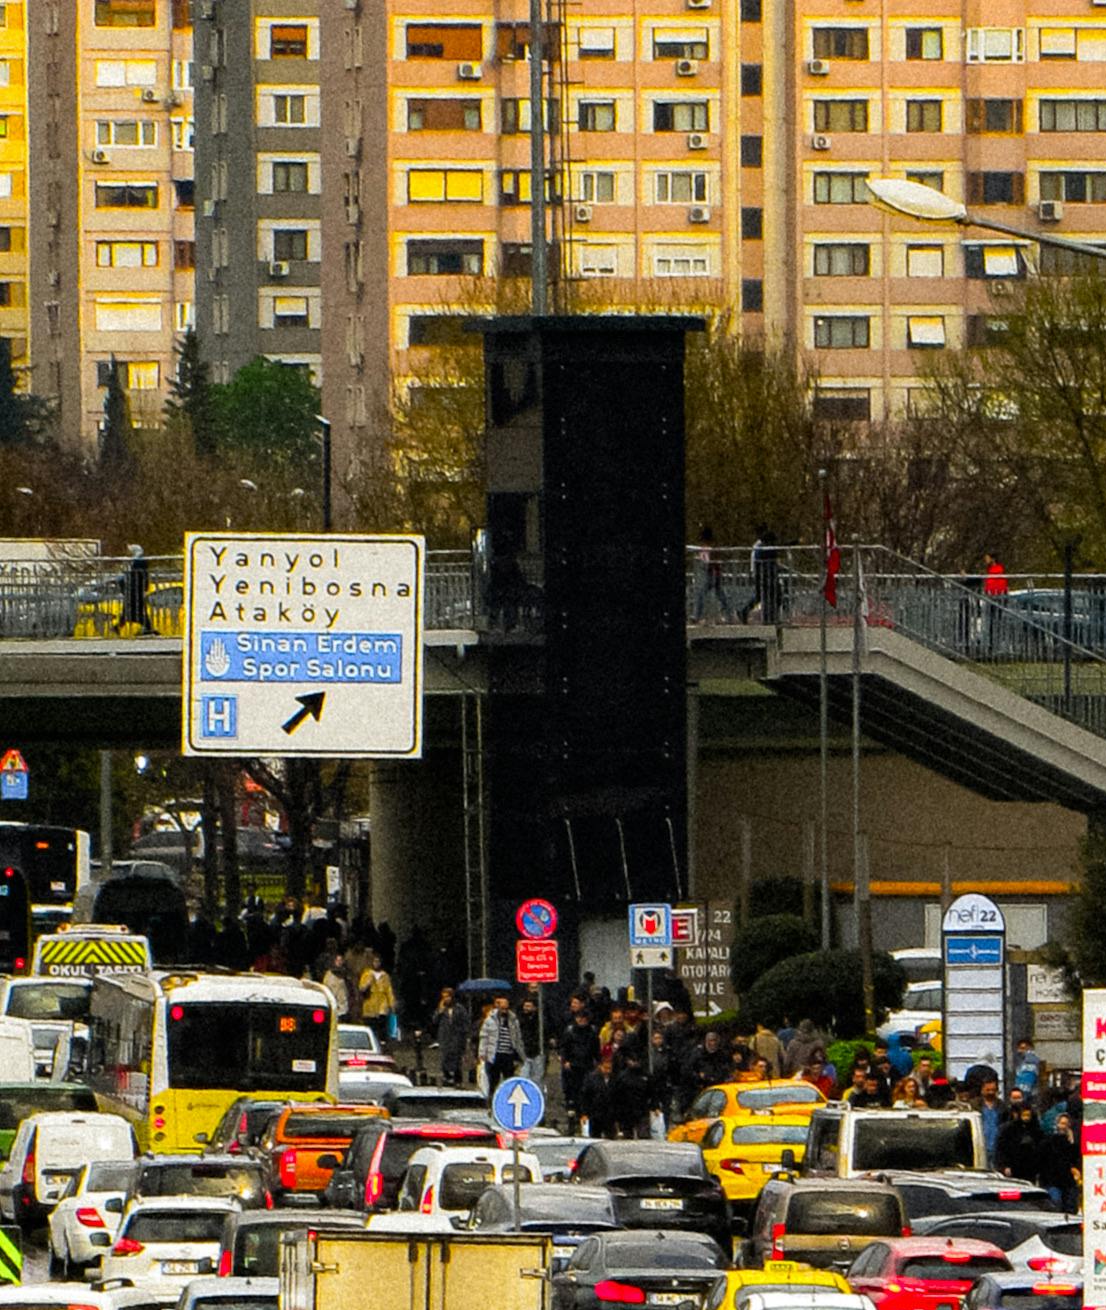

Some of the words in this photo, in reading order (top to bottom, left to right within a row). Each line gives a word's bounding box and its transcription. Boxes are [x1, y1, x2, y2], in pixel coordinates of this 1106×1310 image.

[209, 546, 338, 573] Yanyol
[209, 574, 411, 597] Yenibosna
[208, 601, 339, 628] Ataköy
[236, 634, 307, 652] Sinan
[316, 634, 397, 653] Erdem
[243, 657, 299, 681] Spor
[307, 659, 392, 678] Salonu
[208, 701, 230, 732] H
[49, 965, 86, 976] OKUL
